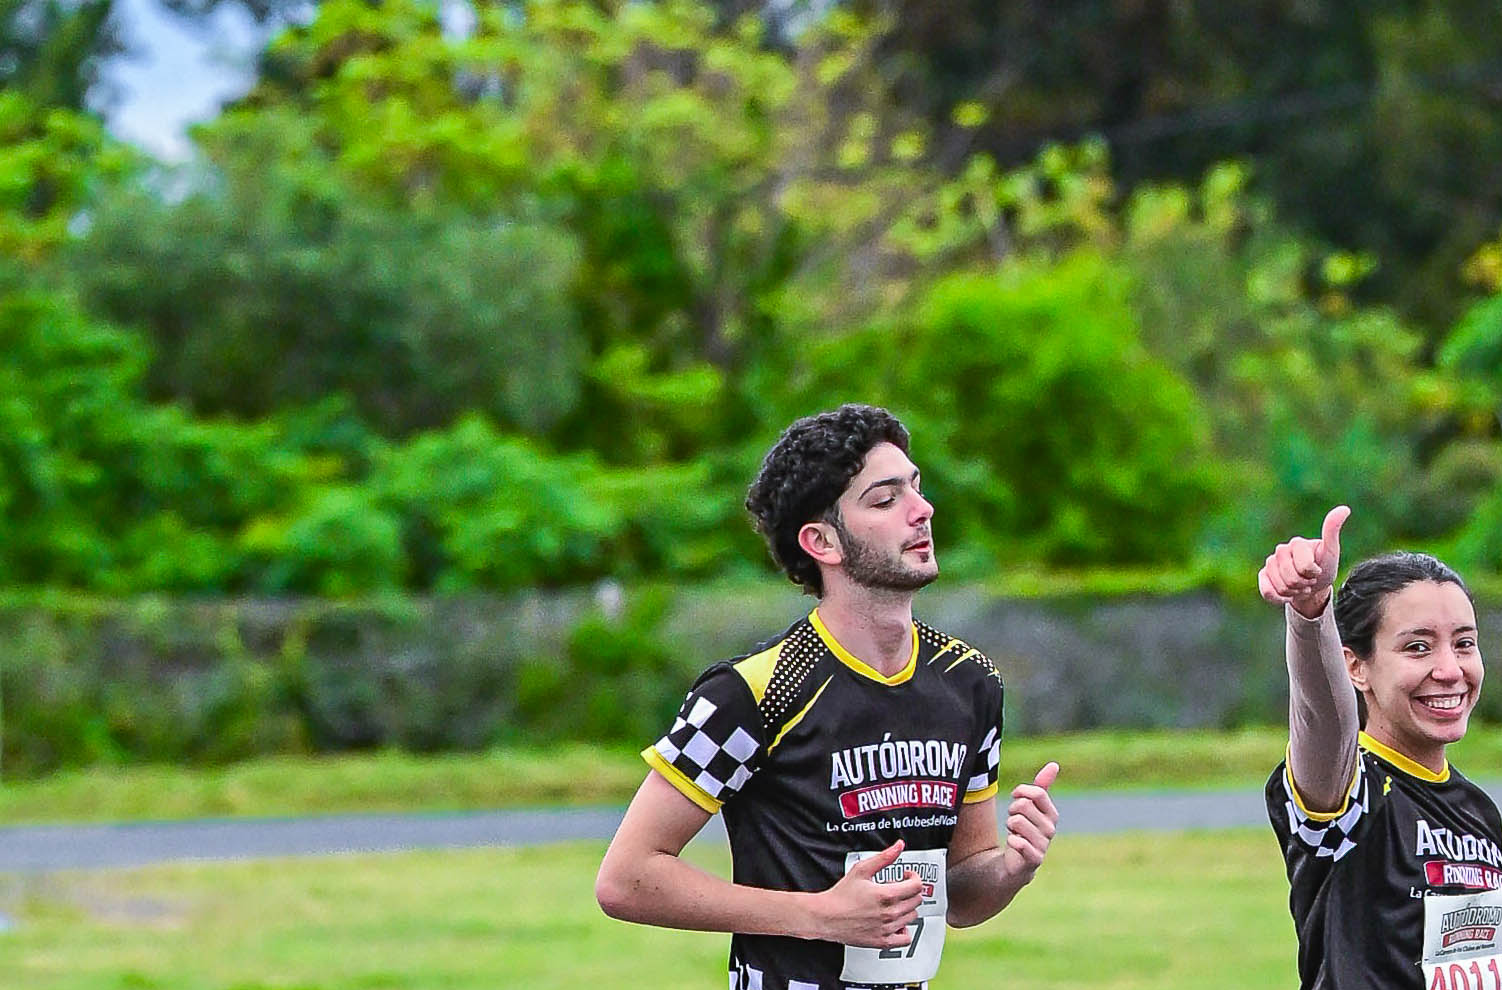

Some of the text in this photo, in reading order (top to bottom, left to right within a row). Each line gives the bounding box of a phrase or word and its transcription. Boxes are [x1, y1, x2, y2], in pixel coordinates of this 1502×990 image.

[857, 783, 954, 813] RUNNING RACE
[878, 818, 891, 829] de
[1410, 887, 1423, 899] La
[879, 918, 924, 959] 7
